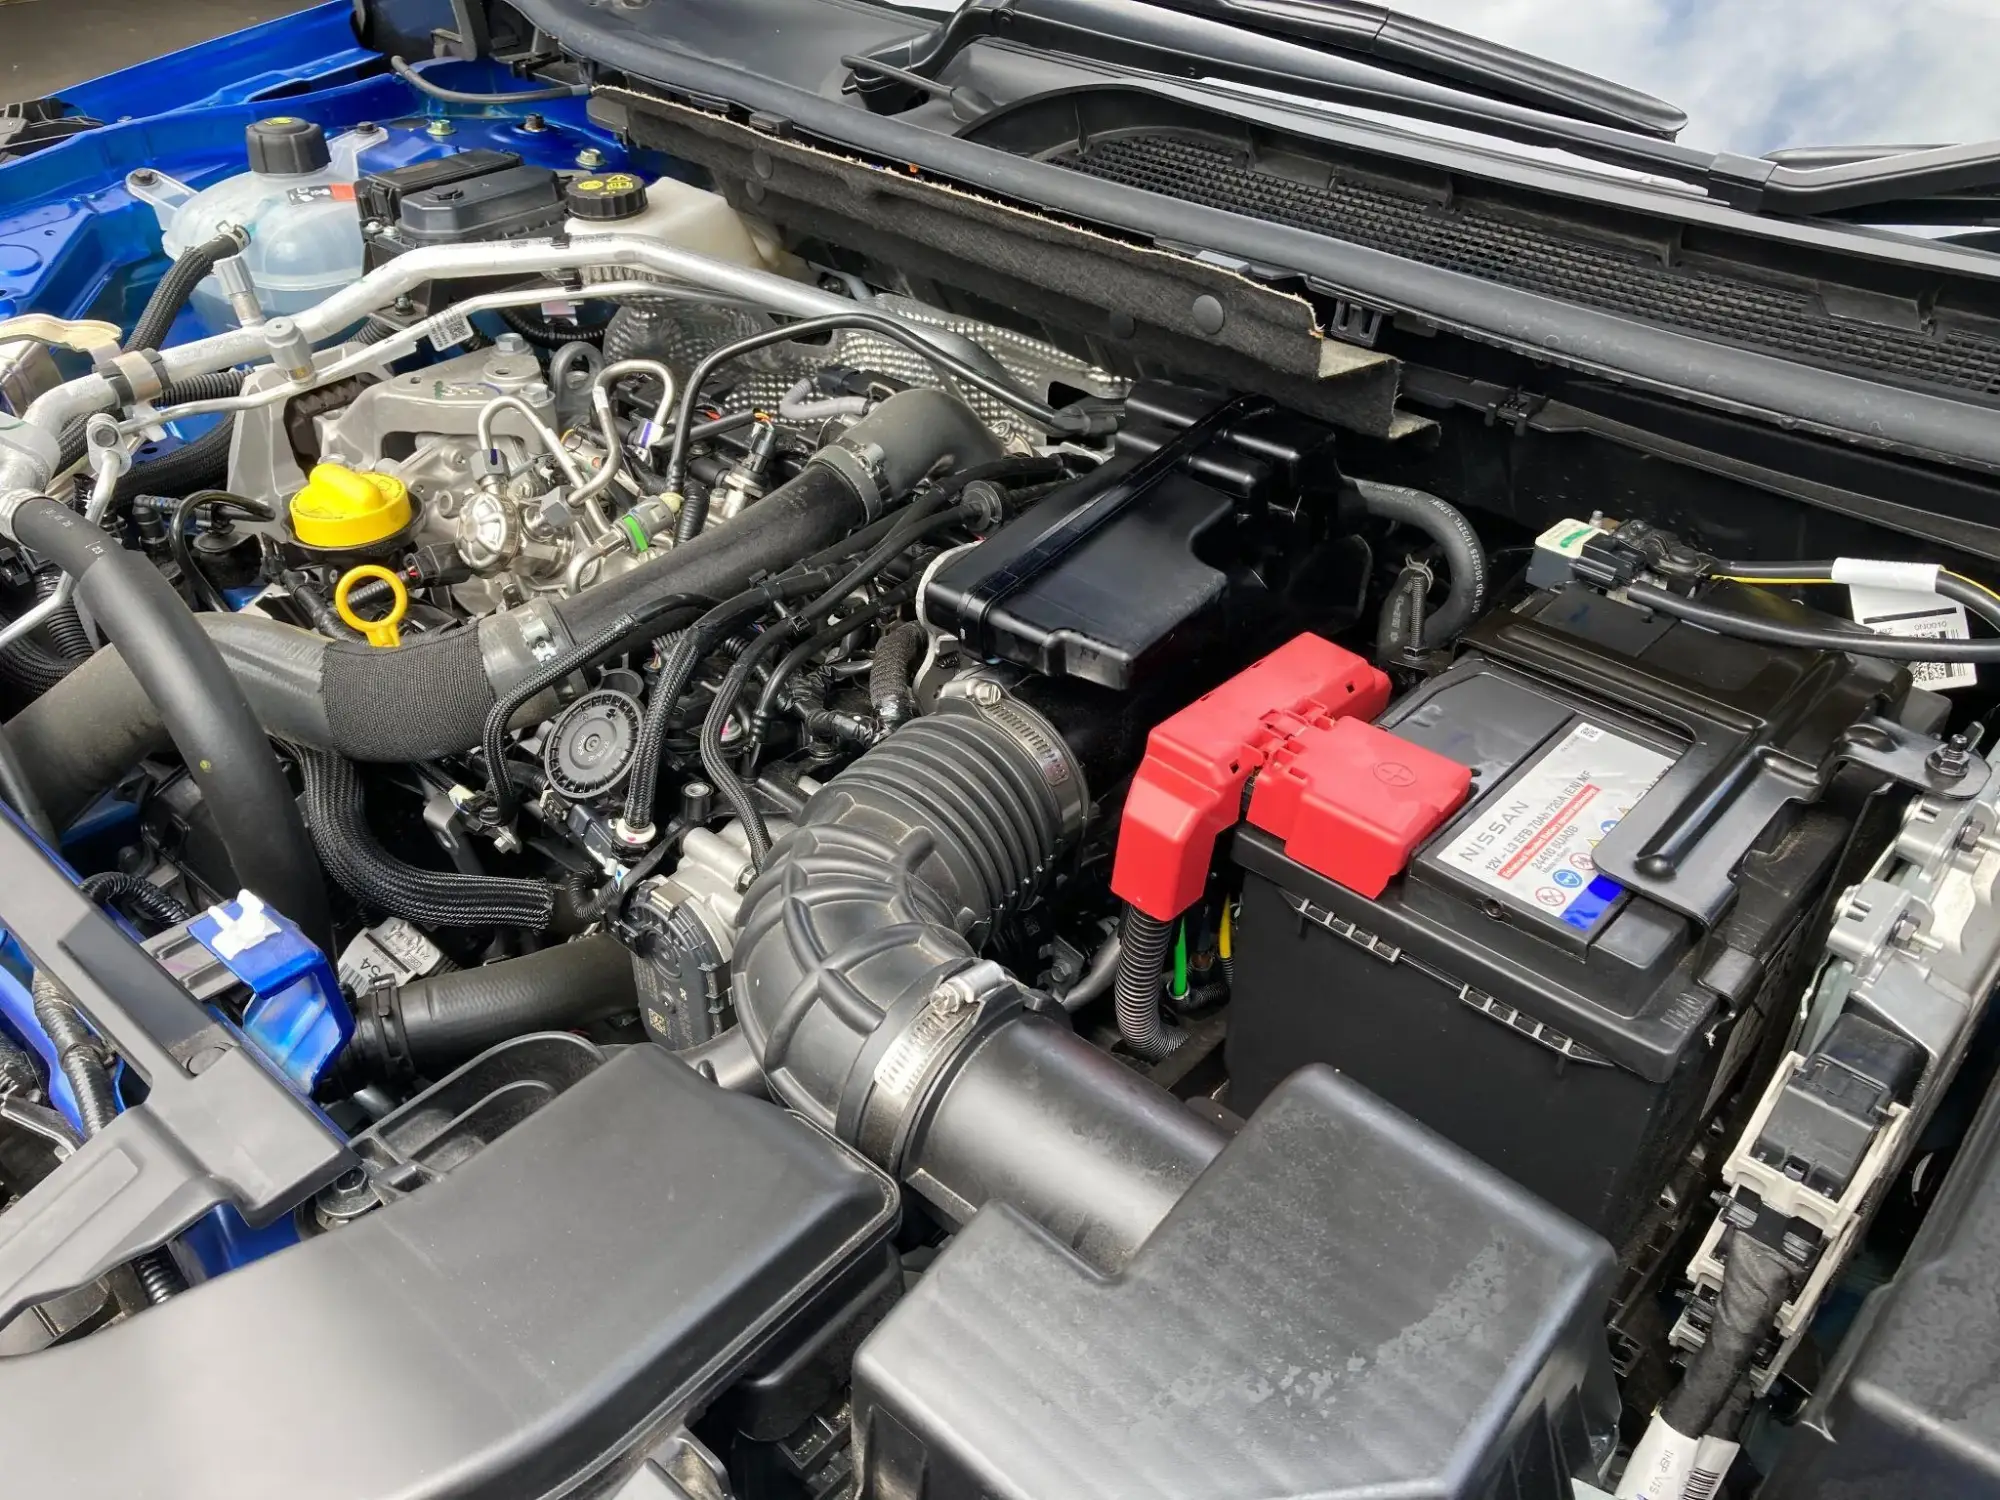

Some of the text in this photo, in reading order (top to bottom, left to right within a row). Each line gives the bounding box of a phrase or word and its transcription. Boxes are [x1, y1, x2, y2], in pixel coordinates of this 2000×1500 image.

[1458, 800, 1530, 861] NISSAN
[1485, 856, 1502, 872] 12V
[1504, 842, 1518, 854] L3
[1513, 828, 1533, 845] EFB
[1528, 811, 1551, 830] 70Ah
[1545, 795, 1570, 813] 720A
[1562, 780, 1585, 797] (EN)
[1577, 769, 1592, 783] MF
[1531, 847, 1557, 870] 24410
